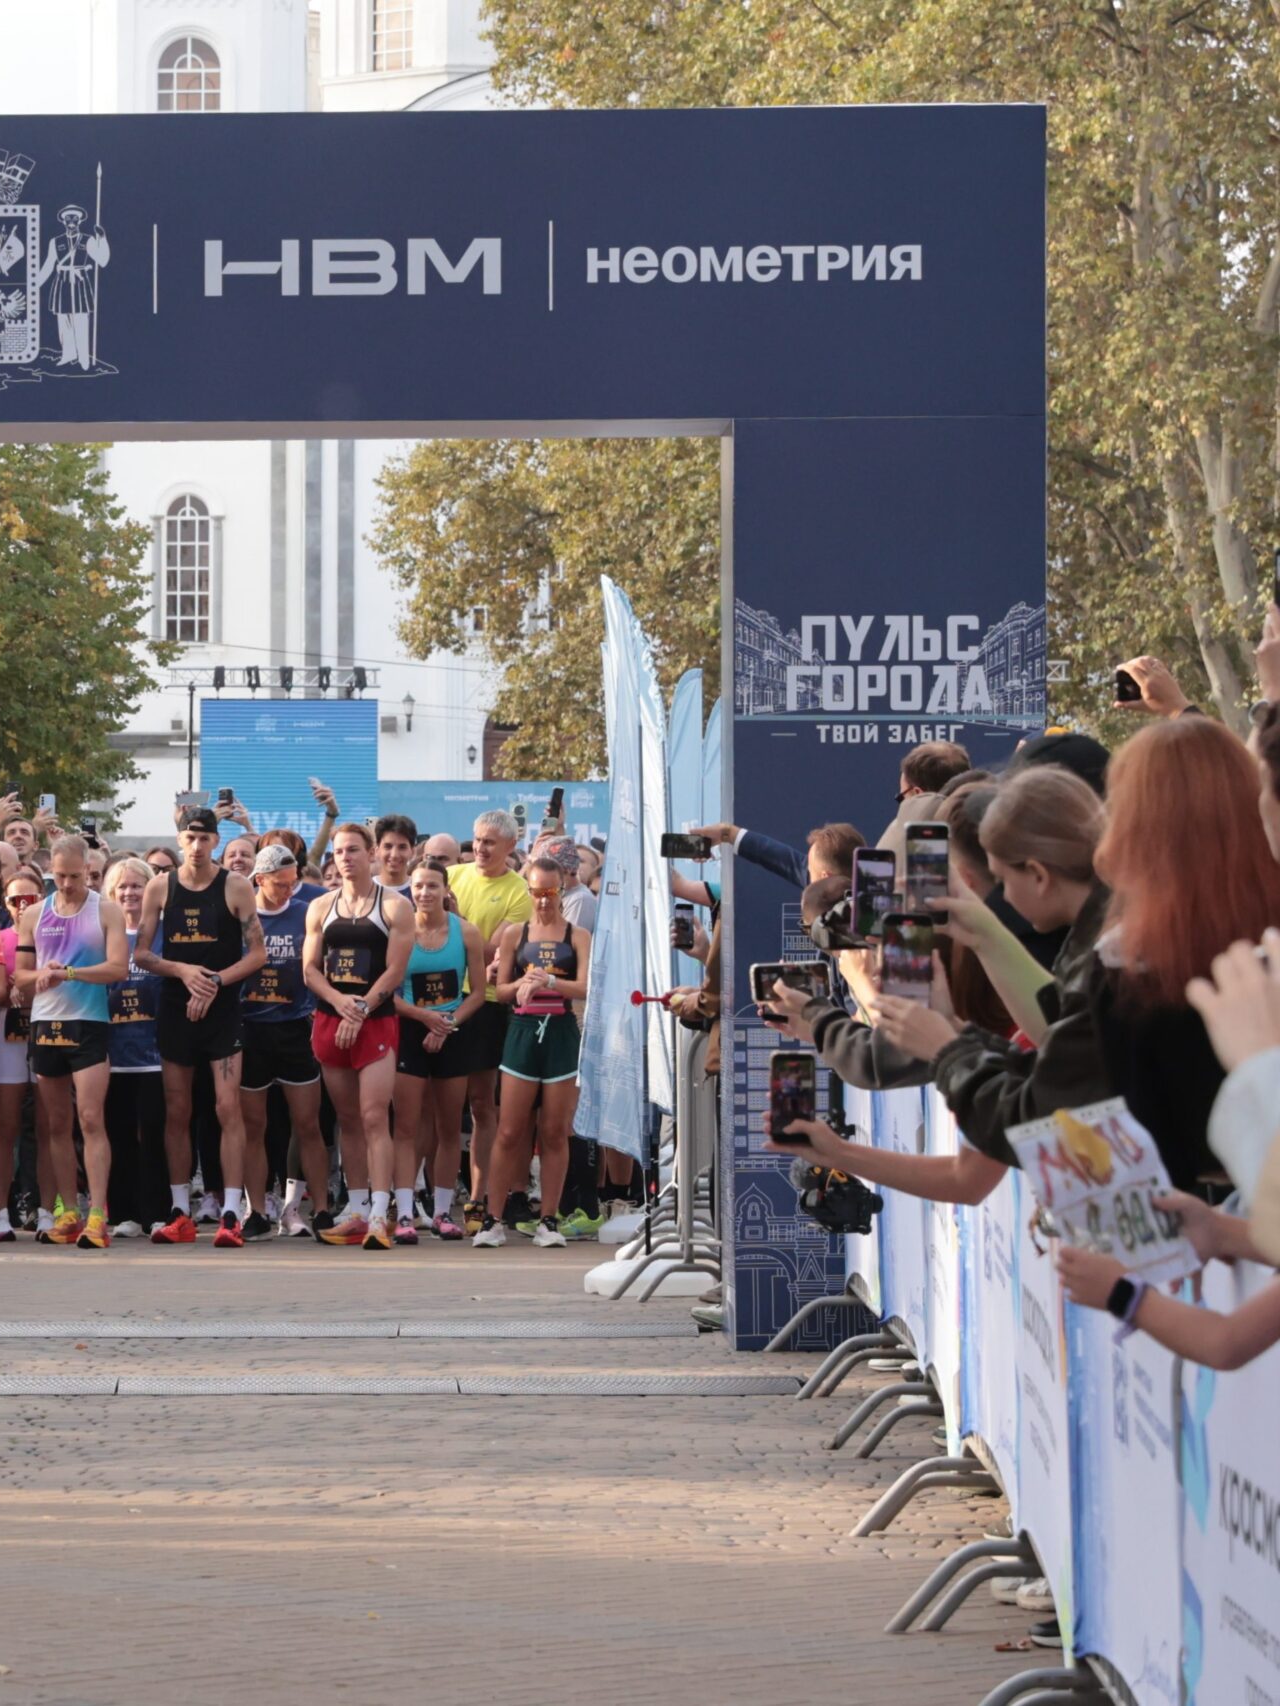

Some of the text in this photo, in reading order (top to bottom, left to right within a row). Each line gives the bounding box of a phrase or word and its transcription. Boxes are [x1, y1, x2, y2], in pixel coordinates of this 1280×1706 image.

[801, 615, 980, 661] ПУЛЬС
[786, 665, 993, 714] ГОРОДА
[816, 723, 964, 744] ТВОЙ ЗАБЕГ
[186, 918, 198, 927] 99
[263, 935, 293, 946] УЛЬС
[265, 946, 295, 957] РОДА
[538, 951, 555, 959] 191
[338, 959, 354, 968] 126
[122, 998, 139, 1008] 113
